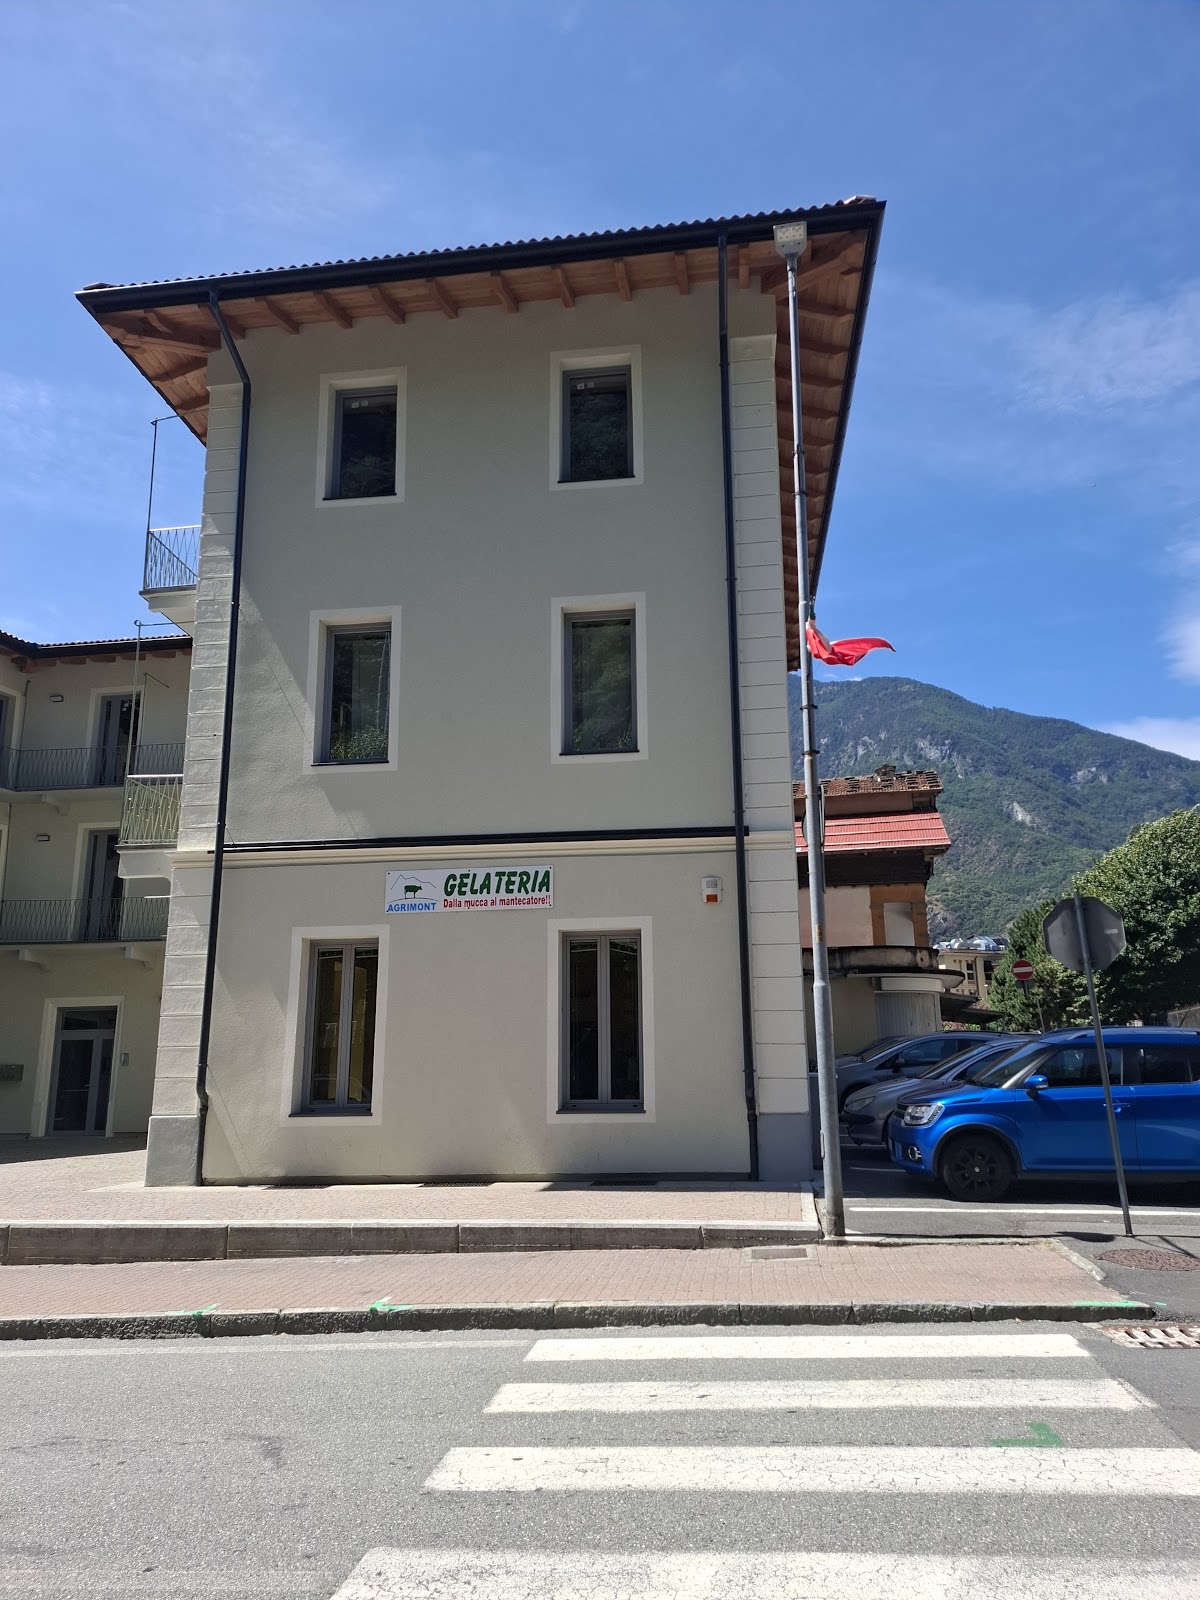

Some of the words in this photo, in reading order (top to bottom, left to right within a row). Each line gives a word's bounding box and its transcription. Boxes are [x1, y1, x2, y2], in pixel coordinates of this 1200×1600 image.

[443, 870, 551, 896] GELATERIA
[387, 902, 437, 912] AGRIMONT
[443, 898, 462, 908] Dalla
[464, 898, 488, 908] mucca
[490, 897, 497, 906] al
[499, 895, 551, 906] mantecatore!!
